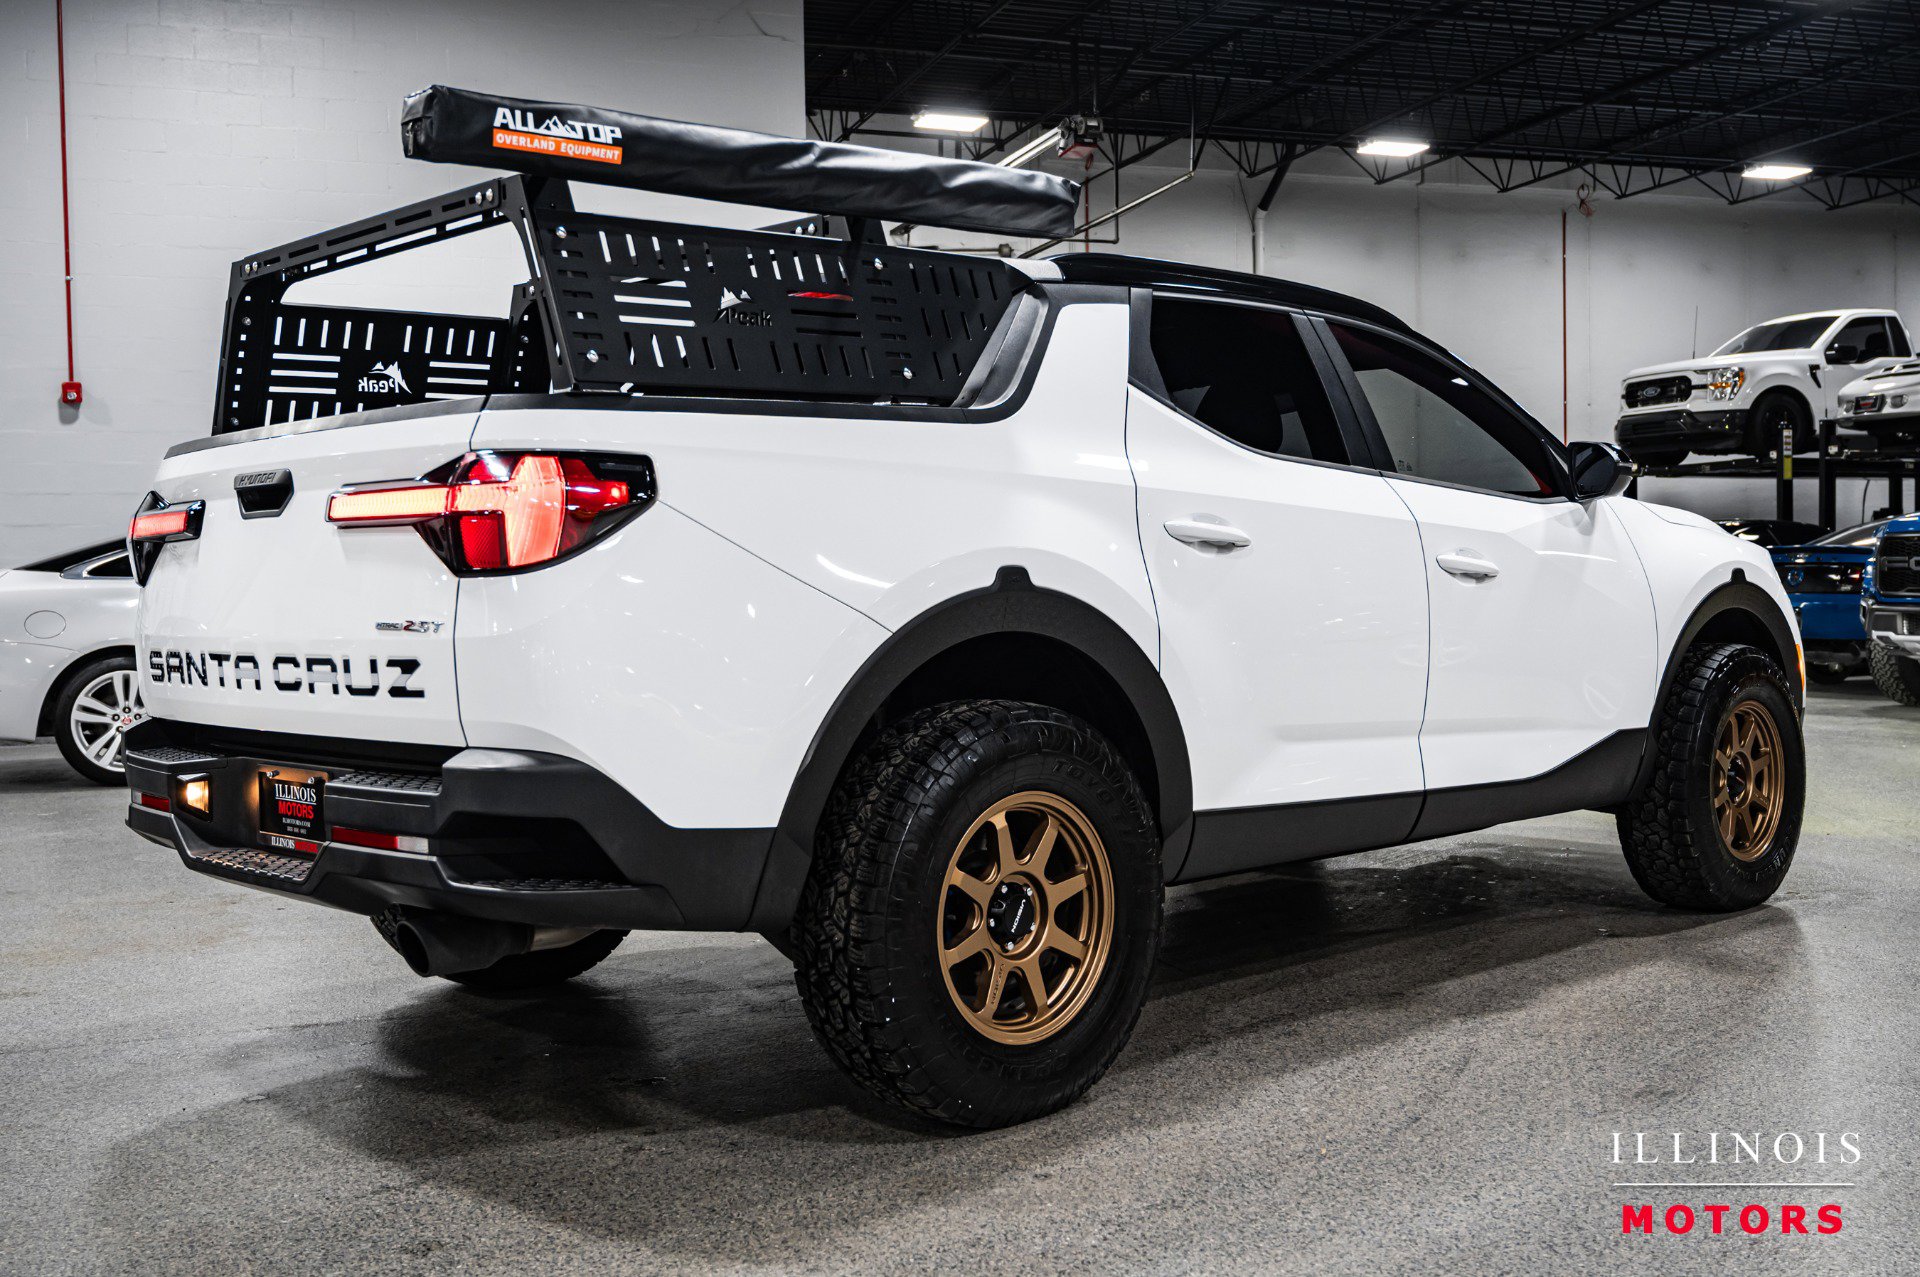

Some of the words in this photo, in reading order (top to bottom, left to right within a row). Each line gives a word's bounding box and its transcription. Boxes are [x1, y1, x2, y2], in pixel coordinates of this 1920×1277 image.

[495, 132, 556, 151] OVERLAND
[560, 141, 620, 161] EQUIPMENT
[727, 307, 773, 327] Peak
[149, 650, 262, 691] SANTA
[272, 655, 426, 699] CRUZ
[274, 783, 317, 803] ILLINOIS
[278, 800, 314, 819] MOTORS
[271, 836, 296, 849] ILLINOIS
[1010, 898, 1027, 934] VISION
